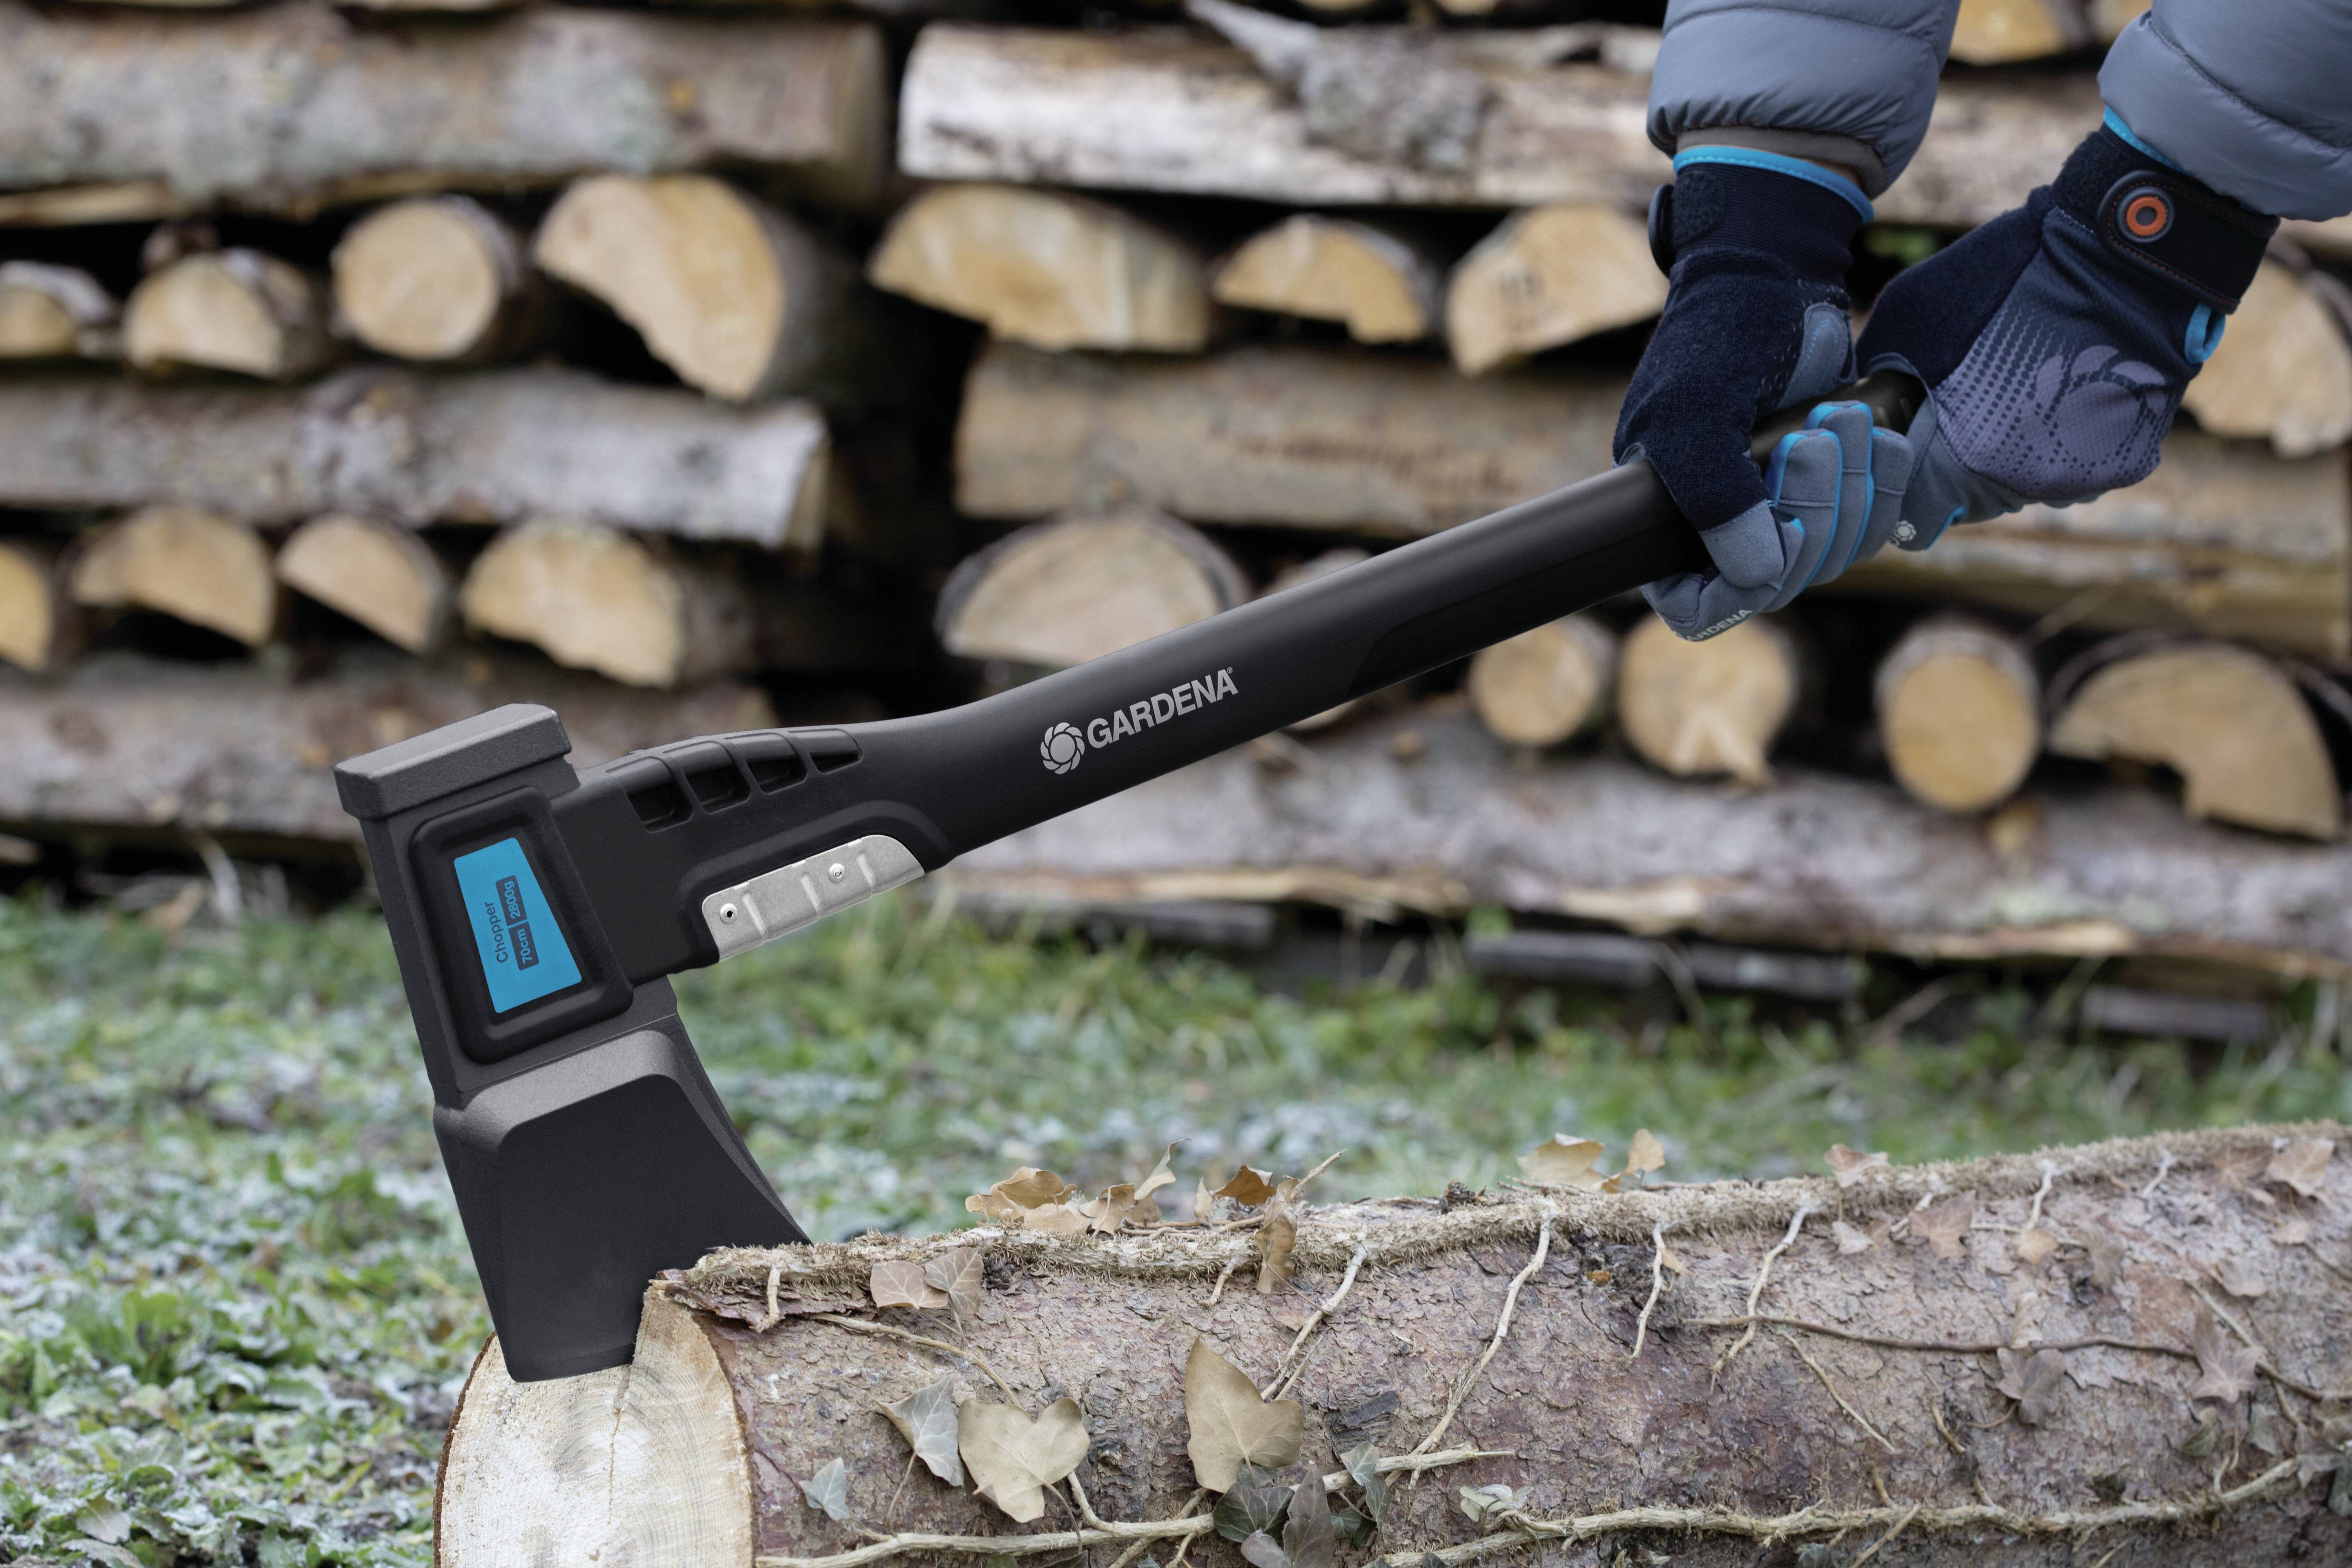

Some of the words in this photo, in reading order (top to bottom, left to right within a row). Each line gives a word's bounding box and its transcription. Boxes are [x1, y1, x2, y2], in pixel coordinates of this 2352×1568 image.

[504, 880, 521, 919] 2800g
[485, 902, 508, 963] Chopper
[518, 929, 532, 964] 70cm
